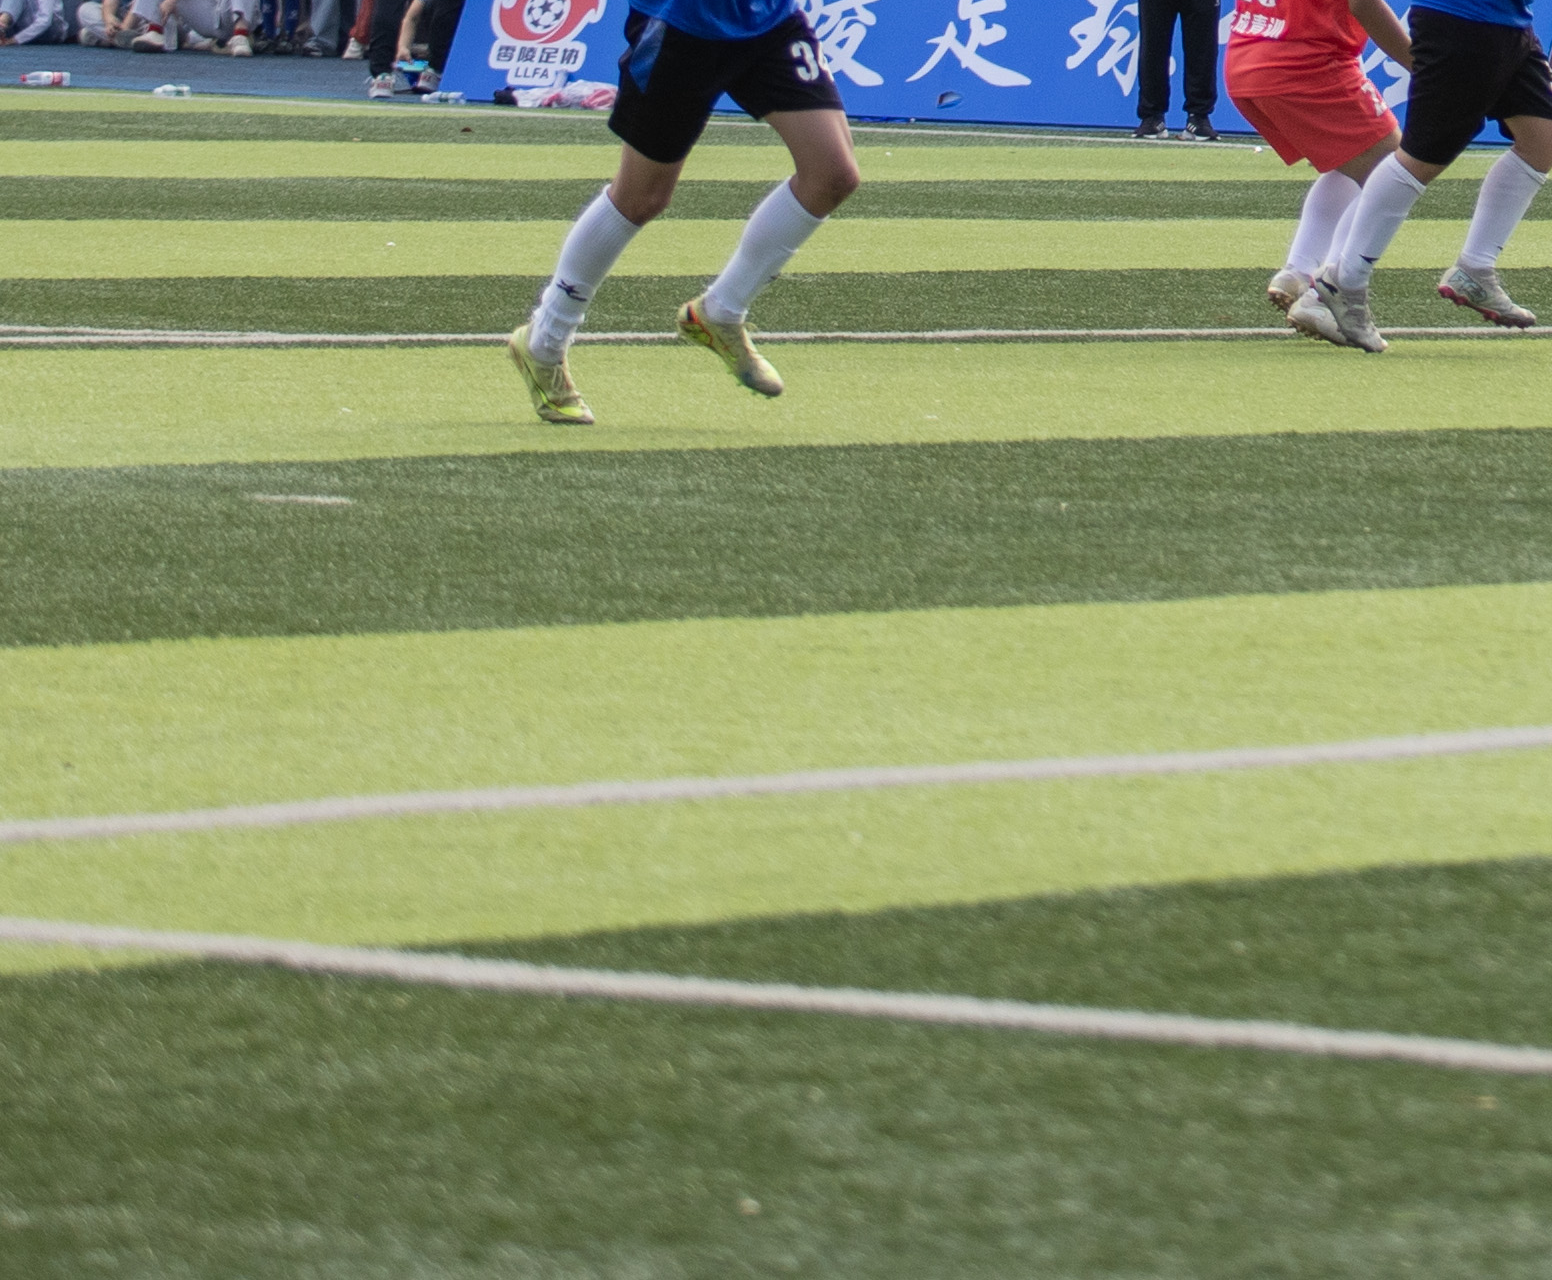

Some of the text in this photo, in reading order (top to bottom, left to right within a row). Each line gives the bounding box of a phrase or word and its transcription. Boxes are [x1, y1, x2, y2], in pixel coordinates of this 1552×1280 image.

[495, 45, 579, 66] 零陵足协
[514, 66, 552, 82] LLFA
